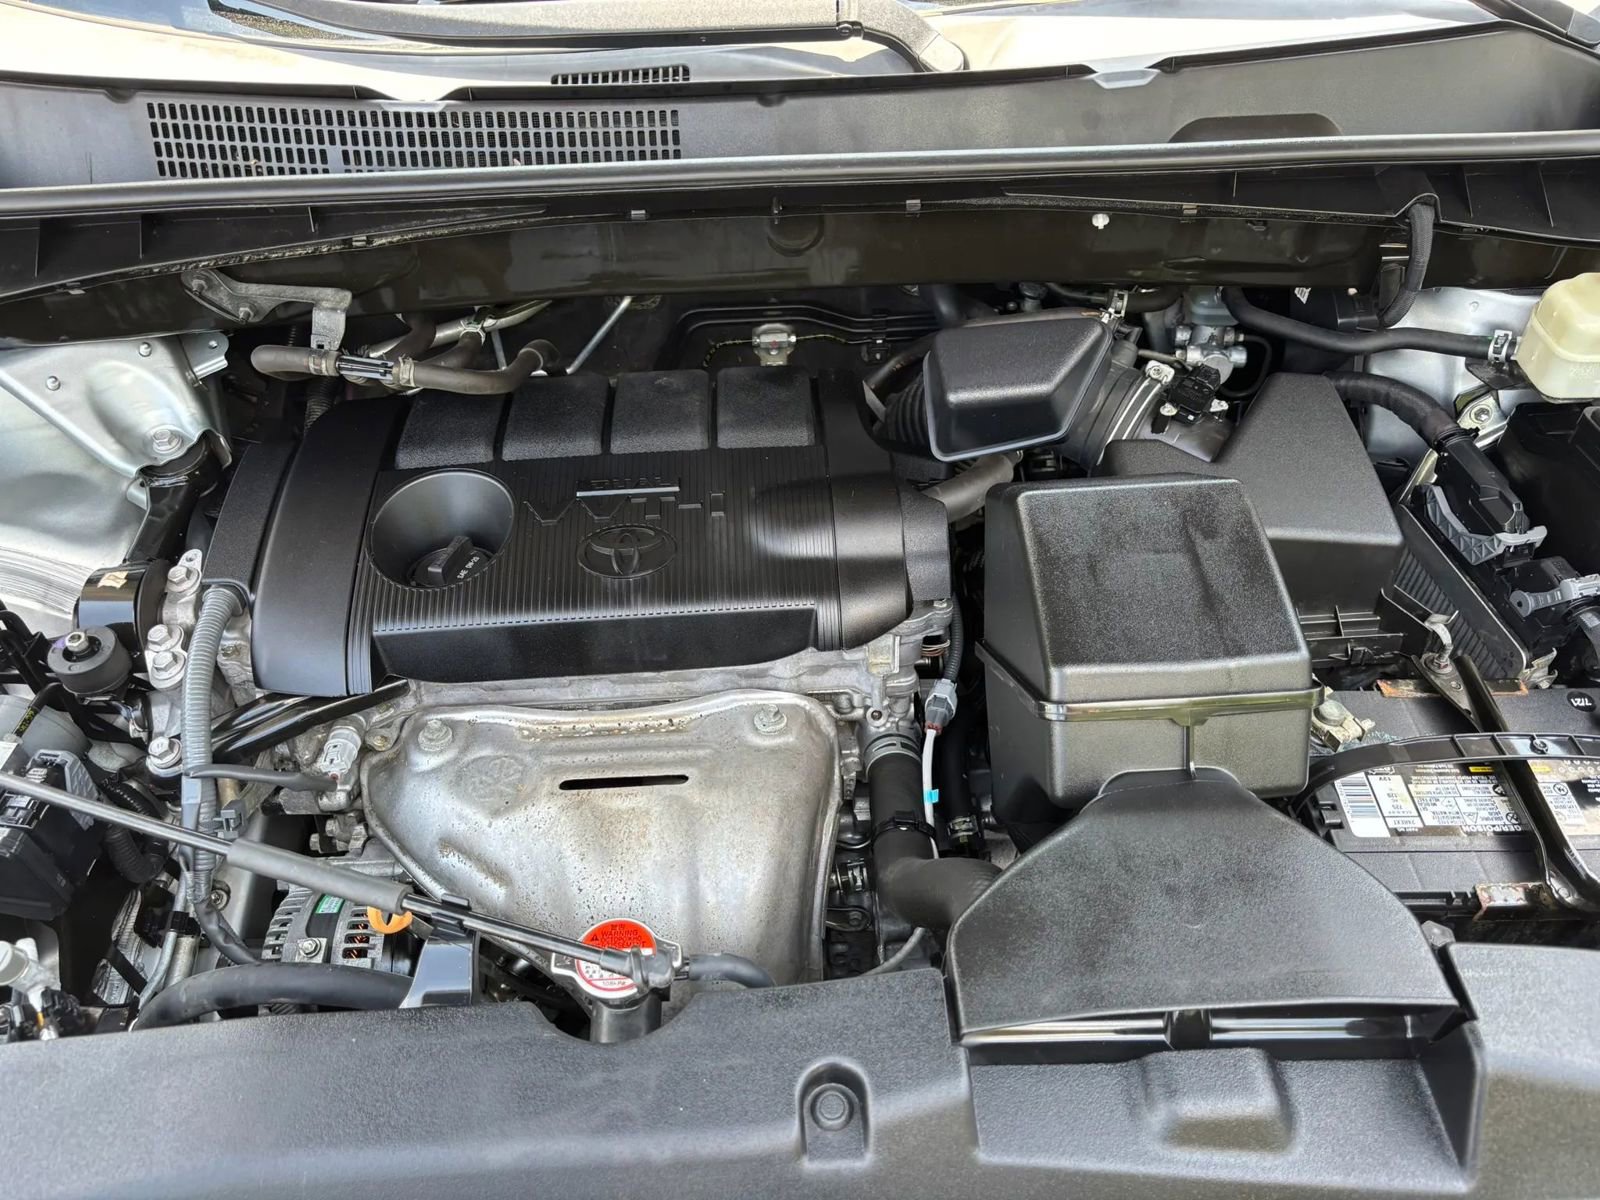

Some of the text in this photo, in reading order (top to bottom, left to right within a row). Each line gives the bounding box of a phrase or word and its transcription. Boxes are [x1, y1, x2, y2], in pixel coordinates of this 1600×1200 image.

[456, 569, 469, 579] SAE
[1461, 824, 1522, 832] GER/POISON
[600, 929, 639, 937] WARNING
